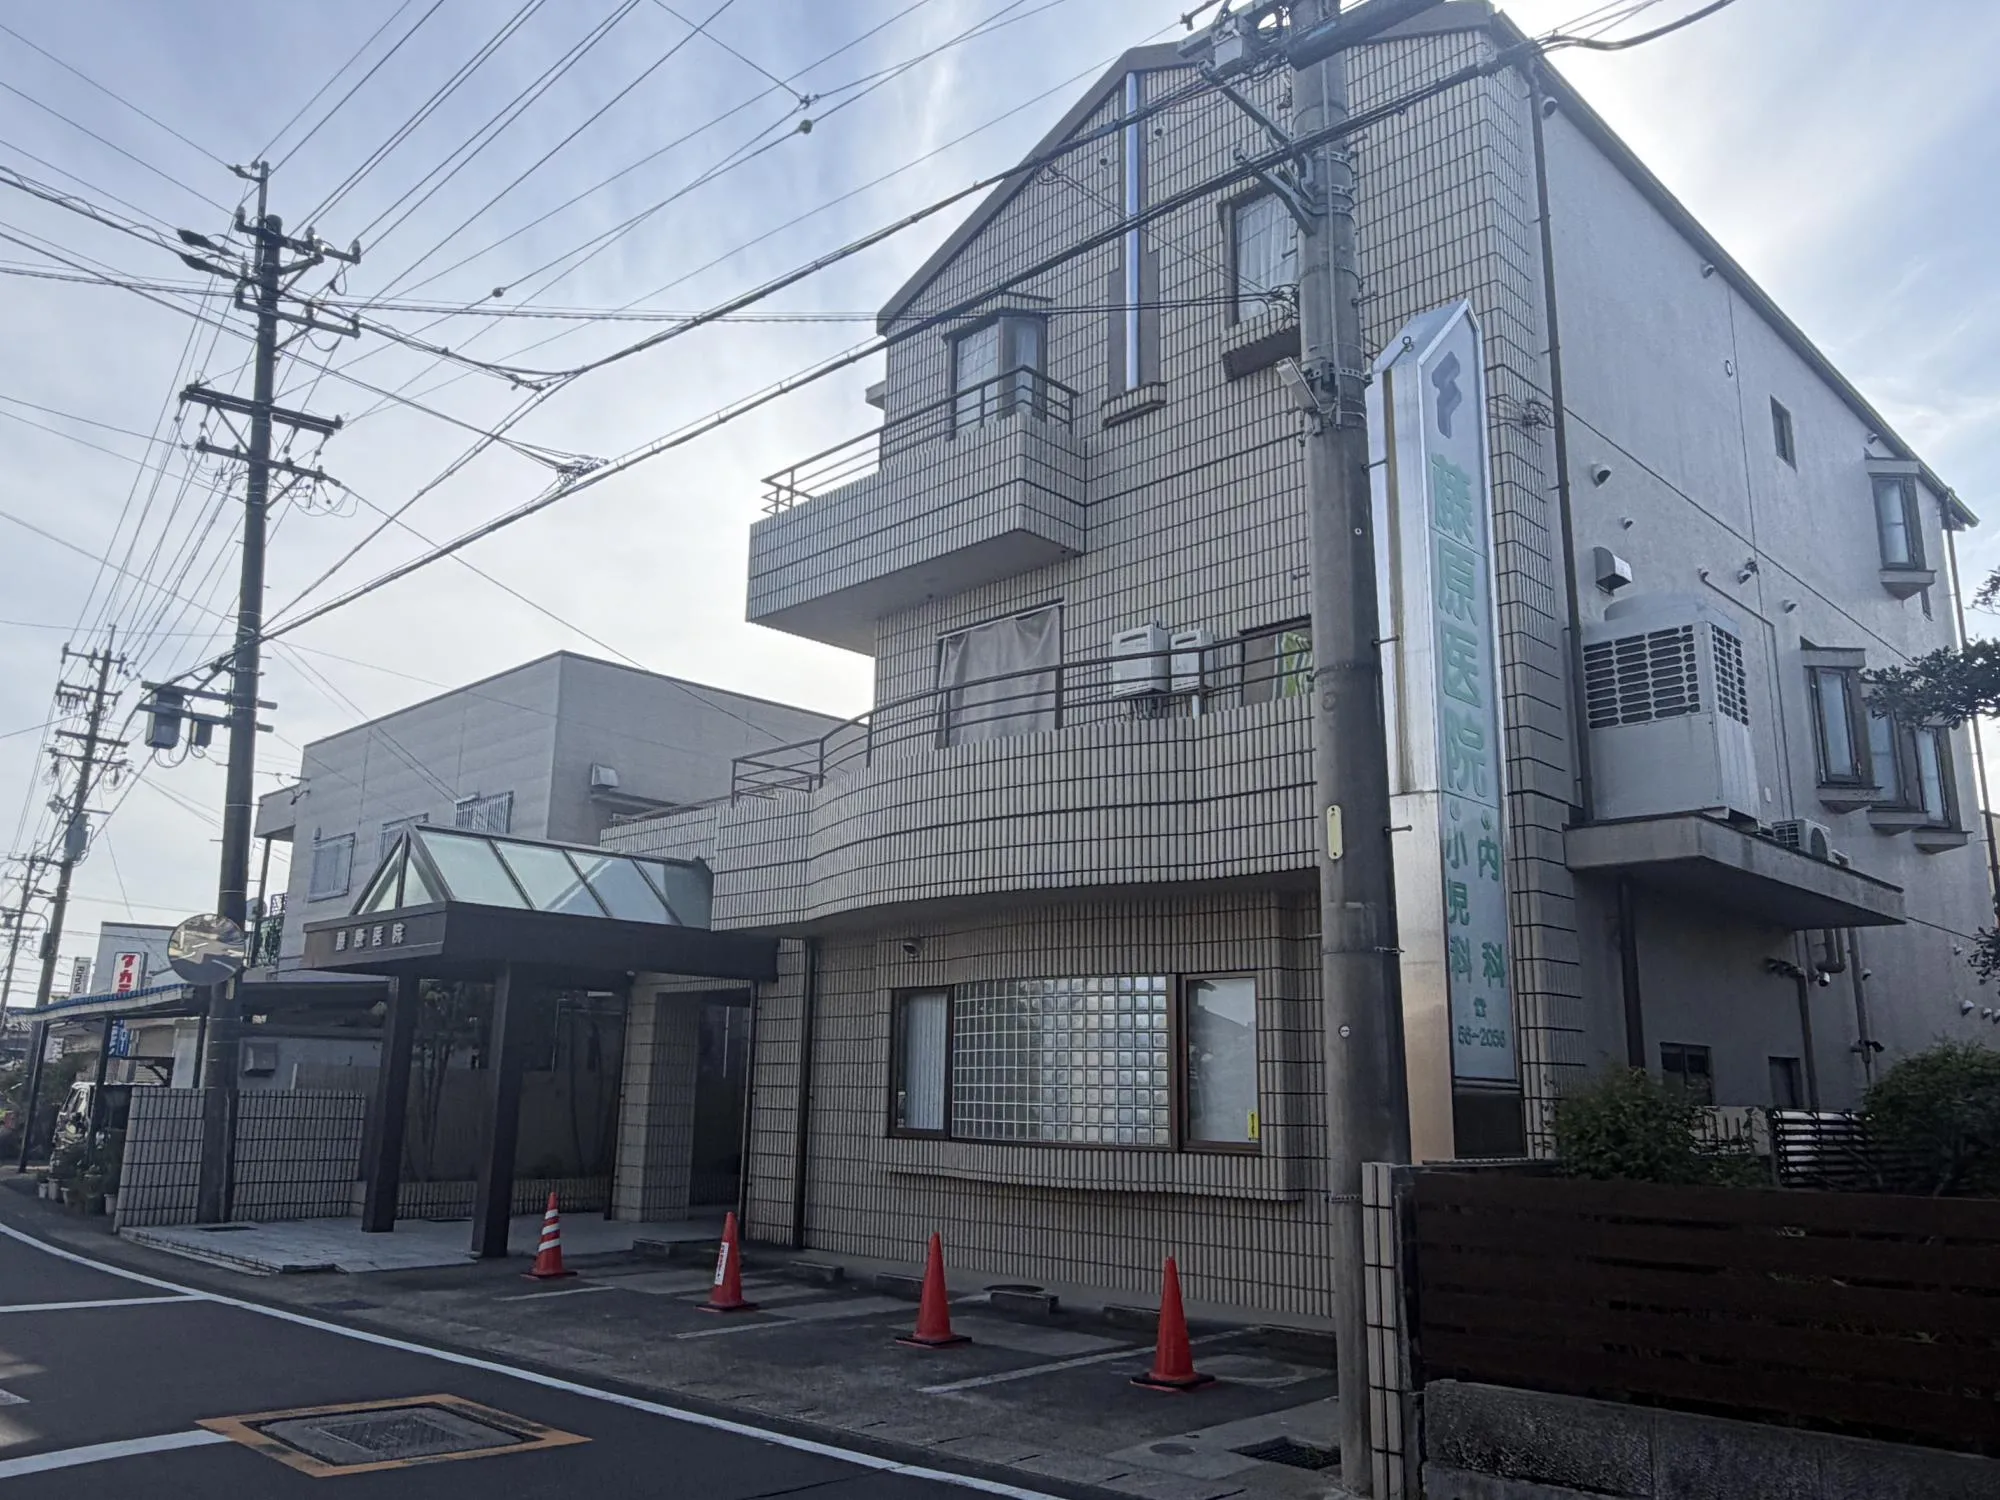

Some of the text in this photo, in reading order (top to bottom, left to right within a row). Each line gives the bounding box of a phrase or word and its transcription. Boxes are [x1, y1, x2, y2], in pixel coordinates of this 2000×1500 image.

[1432, 453, 1487, 797] 藤原医院
[1446, 827, 1471, 983] 小児科
[1477, 836, 1505, 988] 内科
